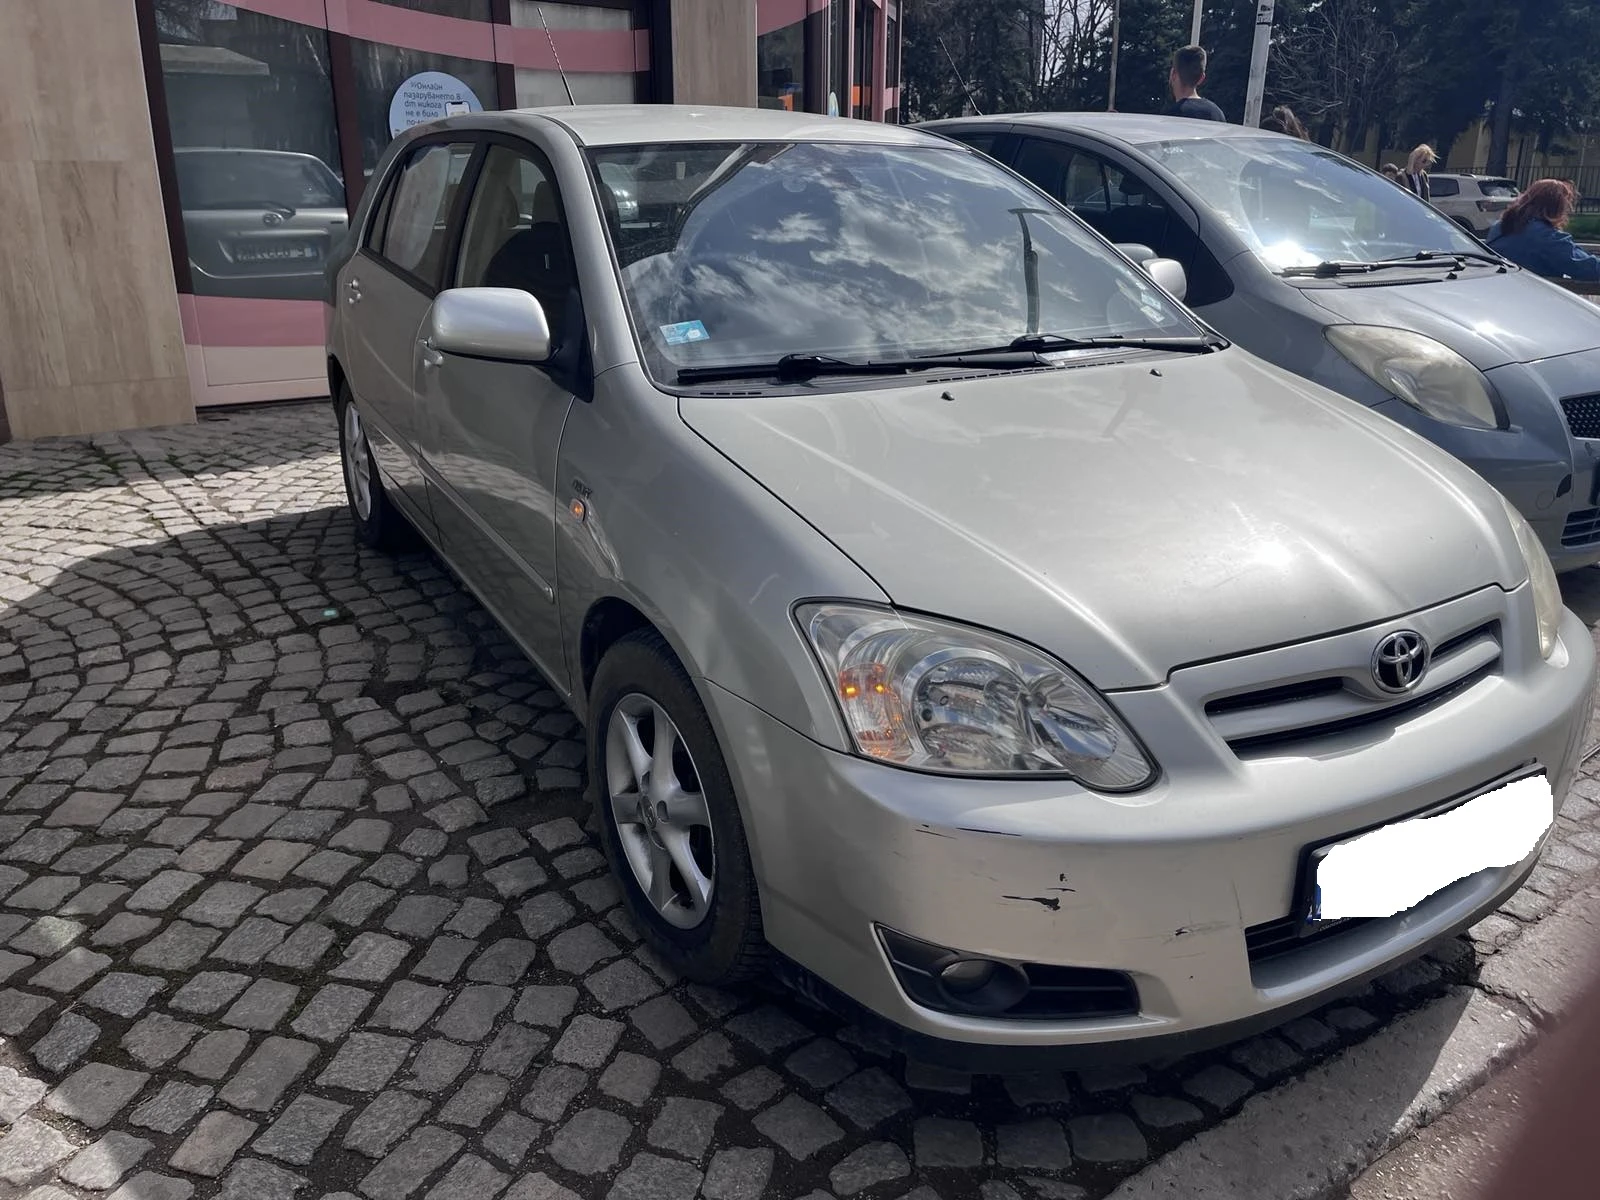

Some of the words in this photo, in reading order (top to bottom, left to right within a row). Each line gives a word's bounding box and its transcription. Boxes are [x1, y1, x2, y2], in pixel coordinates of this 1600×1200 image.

[403, 91, 455, 101] пазаруването
[417, 101, 442, 109] никога
[421, 110, 439, 118] било
